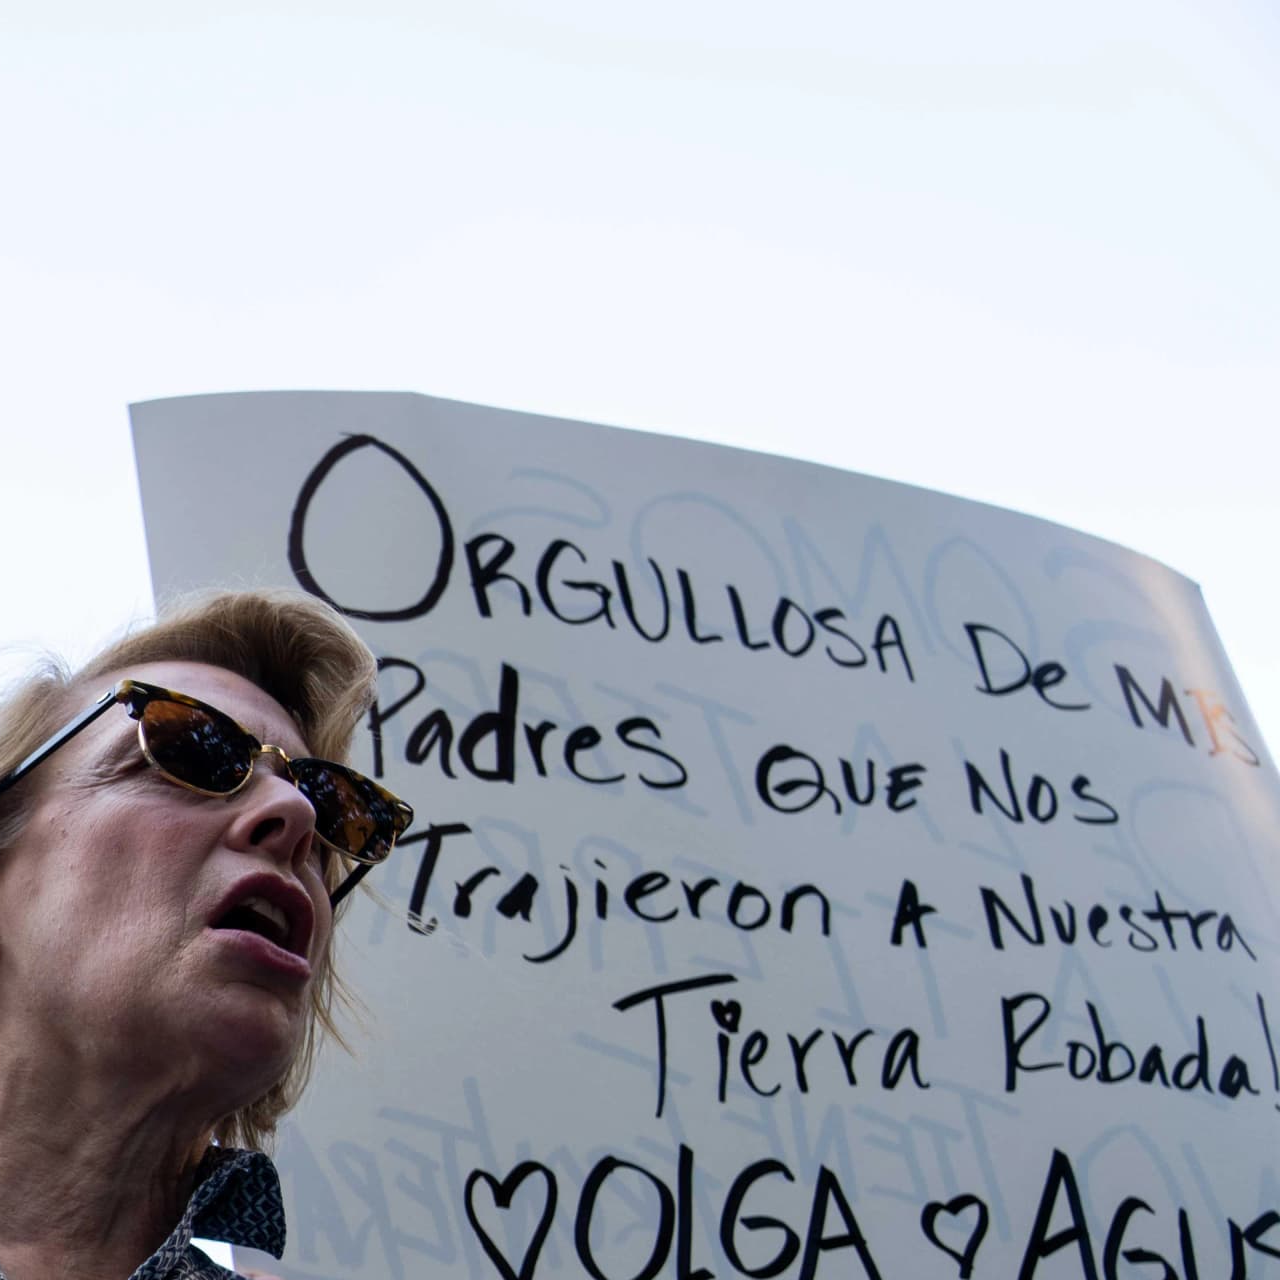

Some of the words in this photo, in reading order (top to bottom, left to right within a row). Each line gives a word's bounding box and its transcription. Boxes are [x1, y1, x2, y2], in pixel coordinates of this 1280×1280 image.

[966, 624, 1091, 714] De
[367, 657, 688, 790] Padres
[755, 744, 928, 816] QUE
[966, 752, 1120, 825] NOS
[393, 822, 831, 962] Trajieron
[891, 878, 938, 950] A
[984, 872, 1257, 961] Nuestra
[612, 972, 931, 1118] Tierra
[1001, 991, 1280, 1112] Robada!
